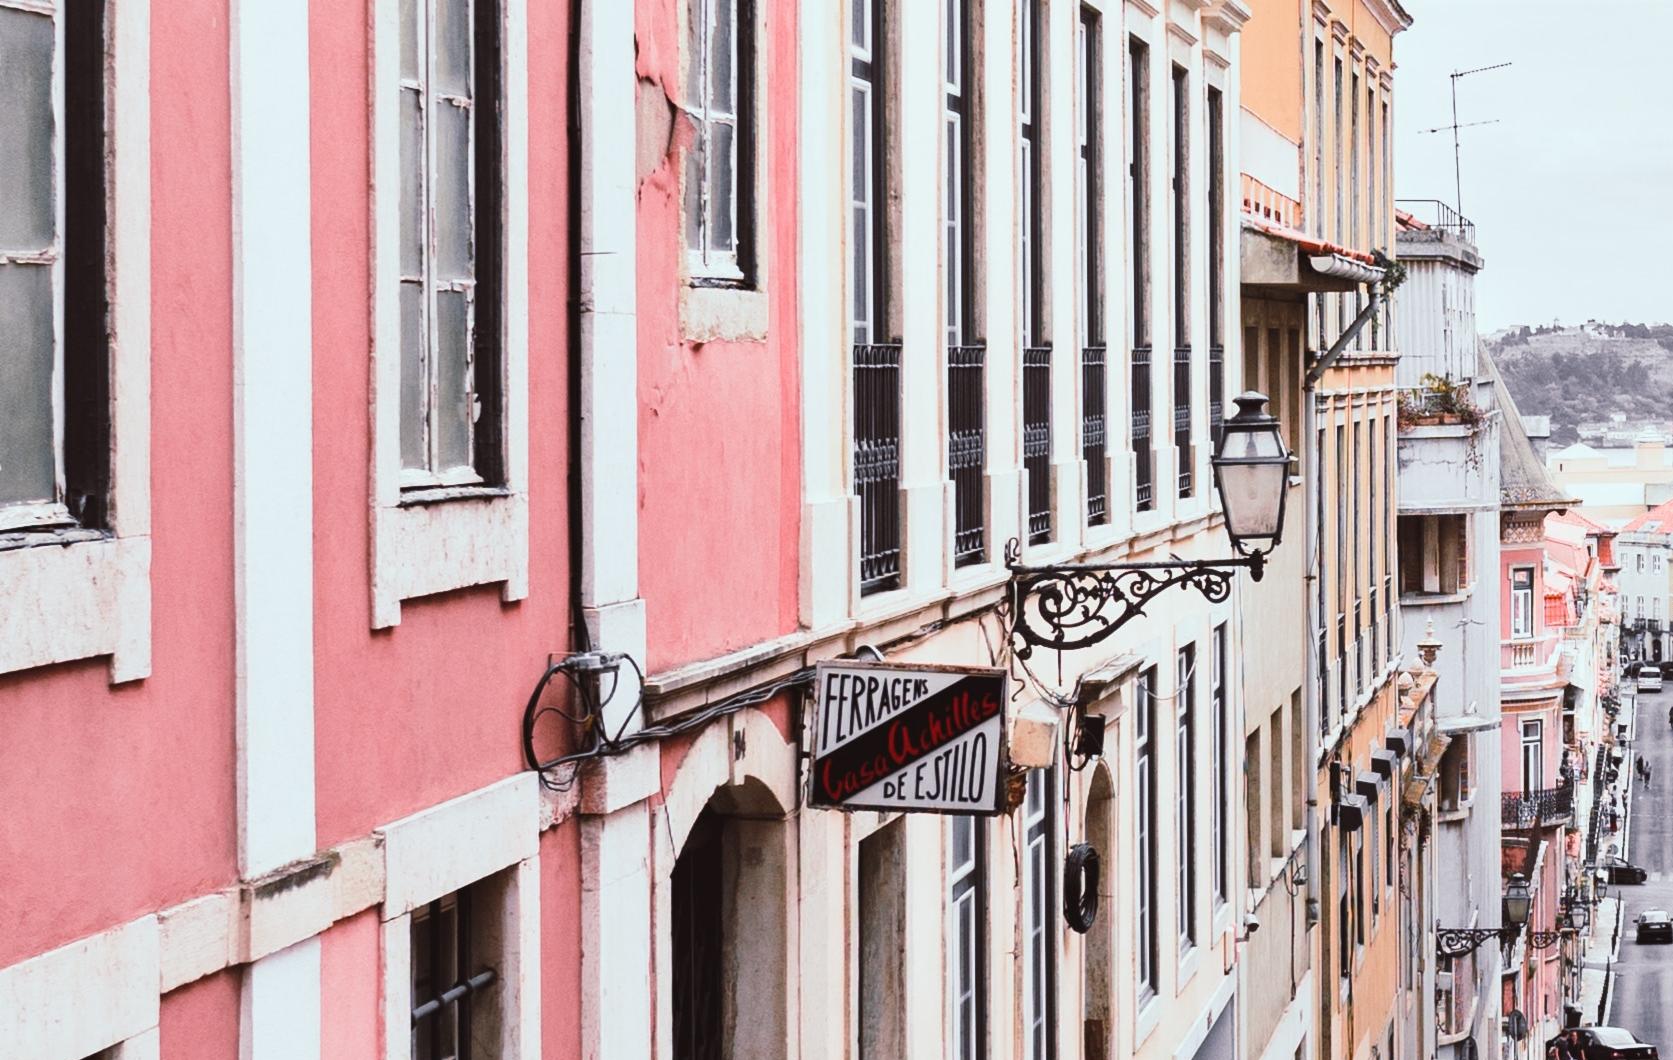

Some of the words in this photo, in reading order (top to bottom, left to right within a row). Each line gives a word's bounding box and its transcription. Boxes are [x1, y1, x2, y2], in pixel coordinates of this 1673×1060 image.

[822, 757, 890, 800] Casa
[888, 690, 998, 766] Achilles
[823, 672, 929, 750] FERRAGENS
[883, 771, 908, 801] DE
[914, 731, 987, 803] ESTILO
